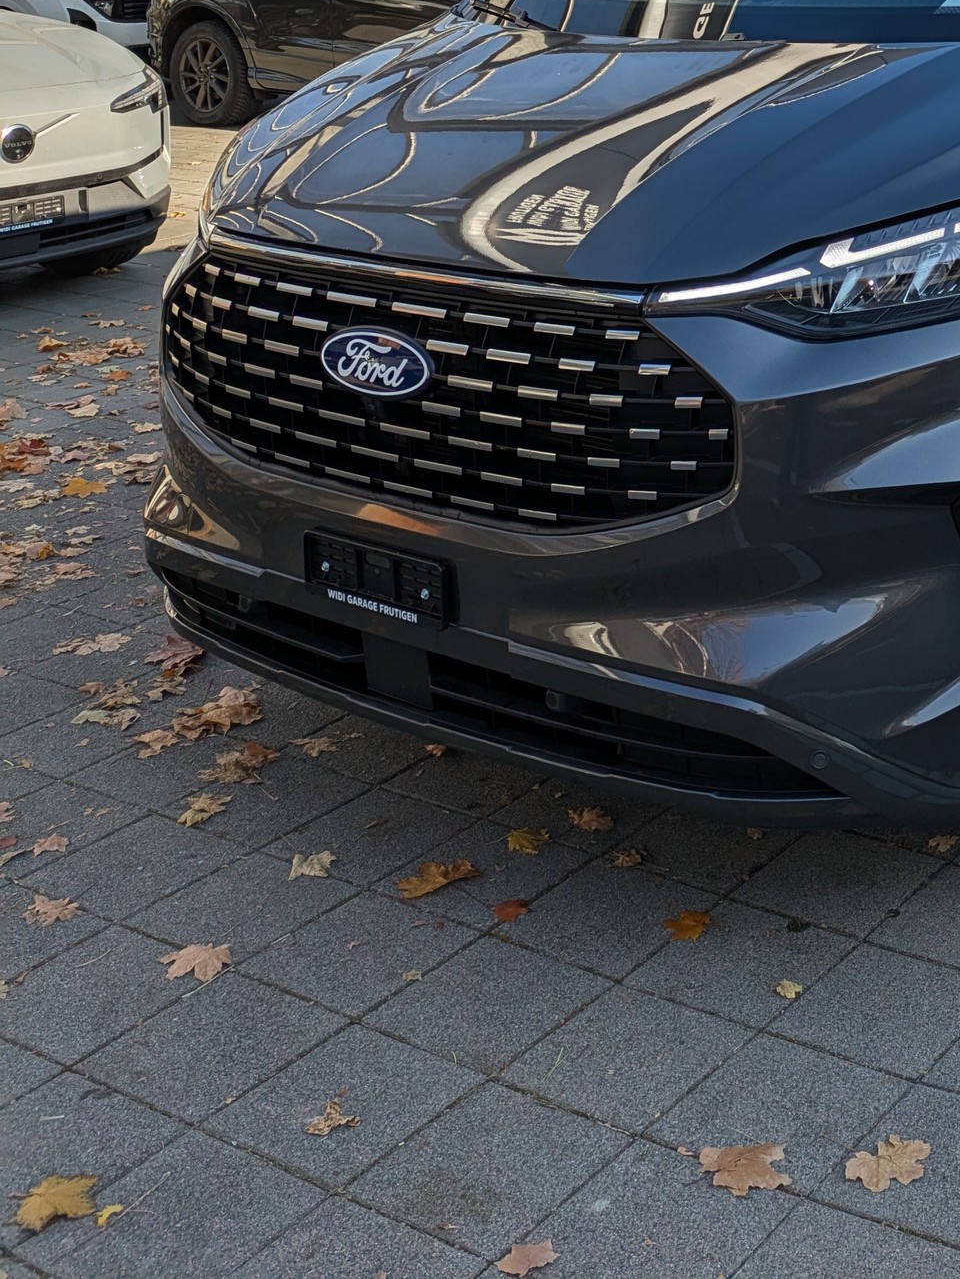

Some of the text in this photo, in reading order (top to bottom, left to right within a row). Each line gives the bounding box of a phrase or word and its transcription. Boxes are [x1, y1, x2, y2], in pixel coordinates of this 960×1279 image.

[3, 140, 32, 149] VOLVO
[11, 223, 30, 231] GARAGE
[30, 218, 53, 227] FRUTIGEN
[338, 338, 408, 388] Ford
[327, 588, 418, 624] WIDI GARAGE FRUTIGEN
